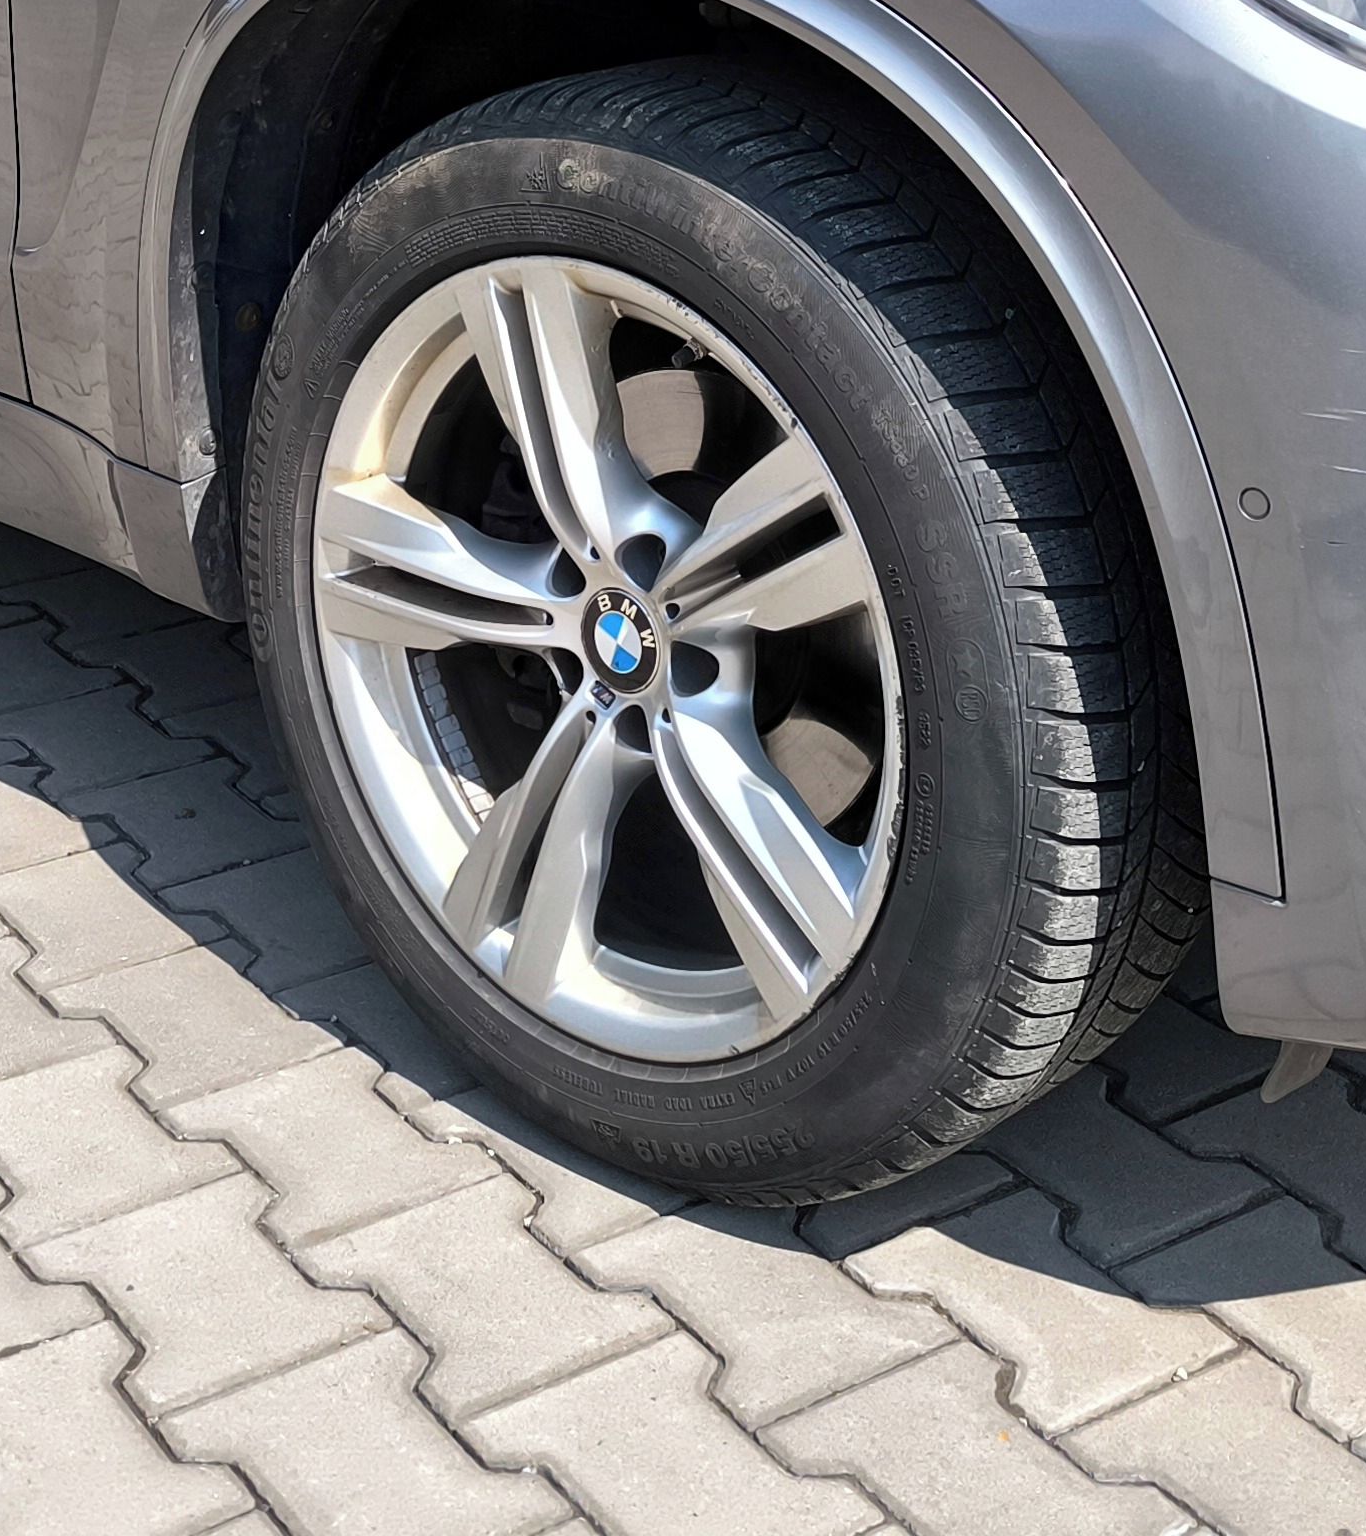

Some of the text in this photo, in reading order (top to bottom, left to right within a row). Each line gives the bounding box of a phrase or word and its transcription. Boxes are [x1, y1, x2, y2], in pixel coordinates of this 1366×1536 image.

[915, 519, 969, 617] SSR
[597, 593, 656, 648] BMW
[632, 1124, 817, 1169] 255/50 R 19
